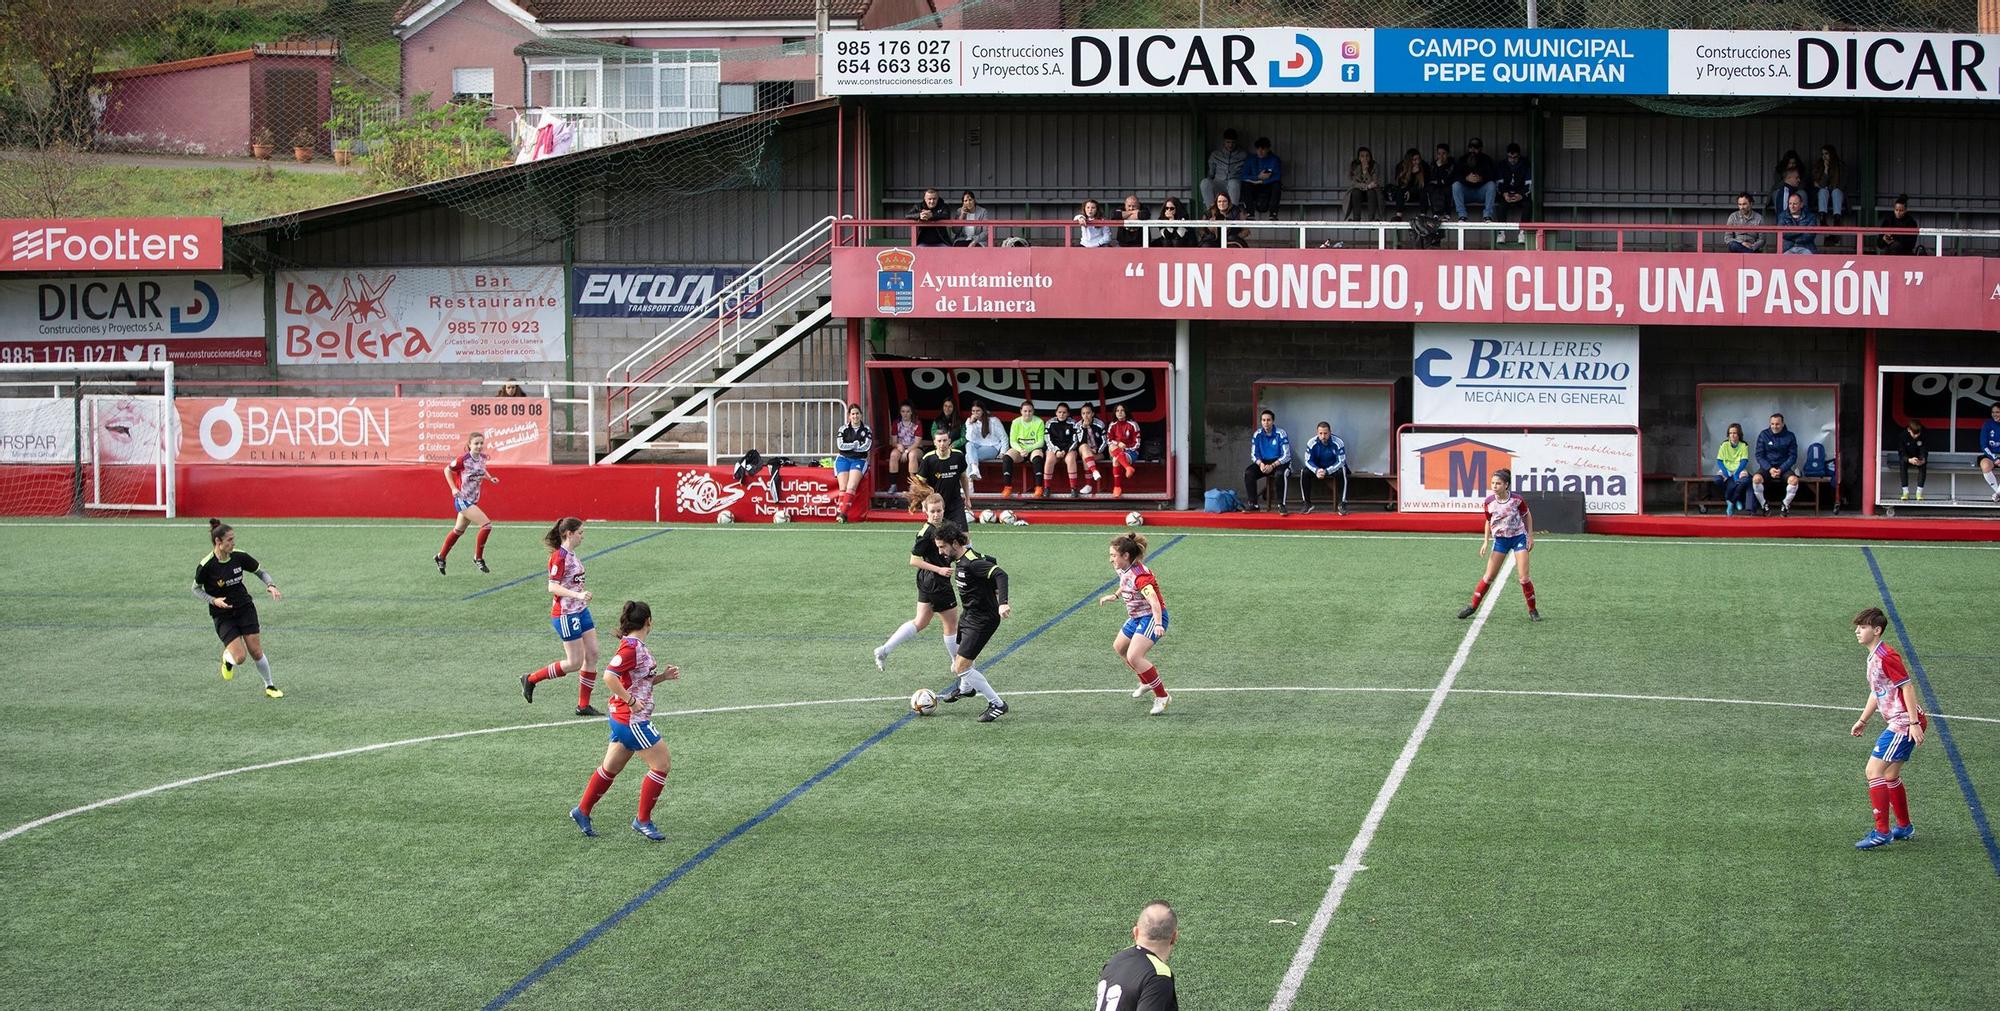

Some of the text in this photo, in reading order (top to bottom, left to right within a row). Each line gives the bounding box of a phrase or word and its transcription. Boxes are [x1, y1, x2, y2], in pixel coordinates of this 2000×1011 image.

[837, 40, 951, 55] 985 176 027
[972, 45, 1064, 58] Construcciones
[1408, 38, 1634, 58] CAMPO MUNICIPAL
[1696, 45, 1791, 59] Construcciones
[837, 59, 951, 73] 654 663 836
[1071, 35, 1258, 87] DICAR
[1797, 37, 1988, 91] DICAR
[972, 63, 1065, 79] y Proyectos S.A.
[1424, 60, 1625, 83] PEPE QUIMARÁN
[1696, 63, 1791, 80] y Proyectos S.A.
[837, 78, 953, 86] www.construccionesdicar.es
[46, 228, 199, 261] Footters
[475, 274, 511, 288] Bar
[579, 274, 715, 304] ENCOSA
[920, 272, 1053, 291] Ayuntamiento
[1158, 262, 1213, 308] UN
[1226, 262, 1424, 316] CONCEJO,
[1438, 265, 1493, 311] UN
[1506, 265, 1625, 318] CLUB,
[1639, 267, 1724, 314] UNA
[1738, 260, 1889, 316] PASIÓN
[38, 281, 163, 321] DICAR
[285, 282, 333, 315] La
[430, 294, 557, 309] Restaurante
[936, 296, 1037, 312] de Llanera
[628, 304, 671, 312] TRANSPORT
[39, 322, 164, 335] Construcciones y Proyectos S.A.
[447, 320, 540, 334] 985 770 923
[1, 345, 116, 362] 985 176 027
[1502, 341, 1603, 357] TALLERES
[911, 367, 1146, 409] OQUENDO
[1464, 390, 1625, 405] MECÁNICA EN GENERAL
[470, 404, 542, 416] 985 08 09 08
[248, 398, 389, 446] BARBÓN
[250, 450, 389, 460] CLÍNICA DENTAL
[1449, 451, 1626, 497] Mriñana
[766, 492, 830, 504] Lantas
